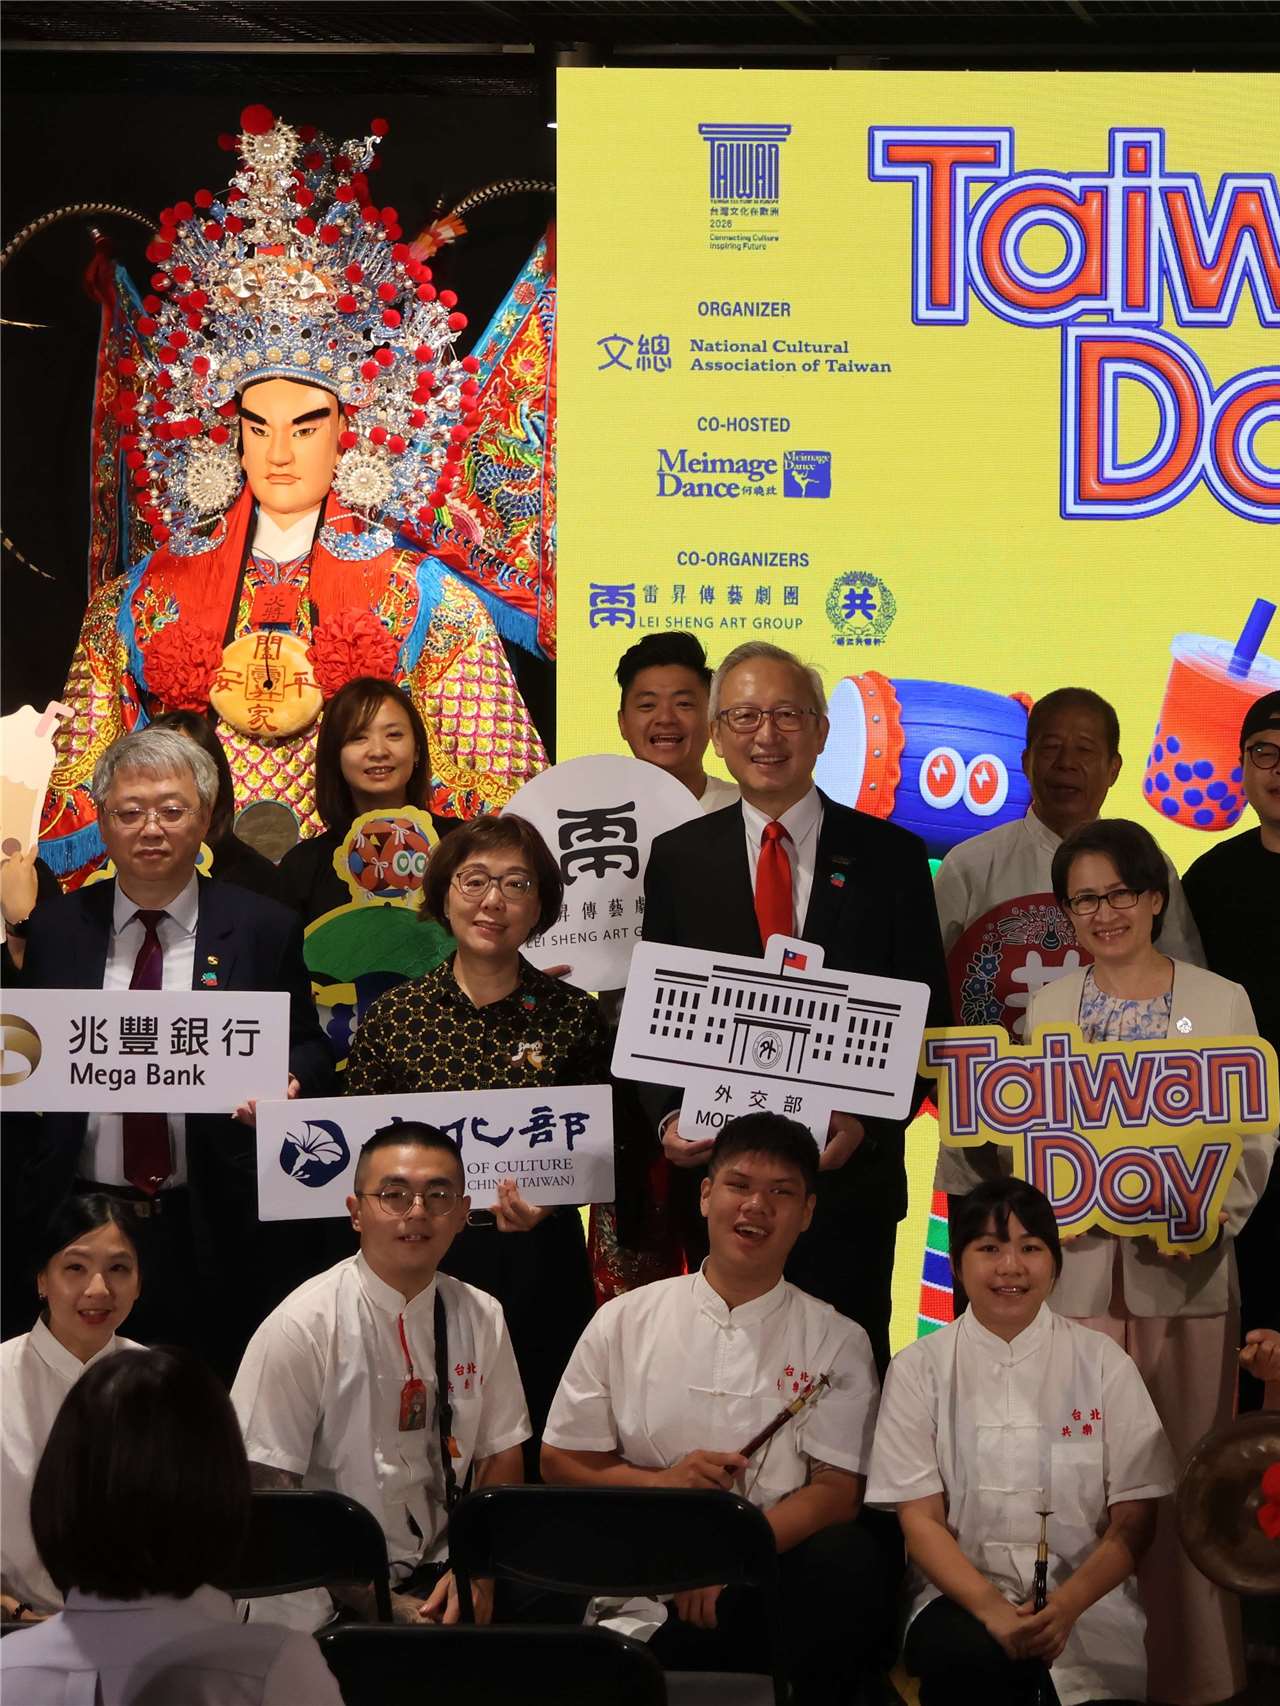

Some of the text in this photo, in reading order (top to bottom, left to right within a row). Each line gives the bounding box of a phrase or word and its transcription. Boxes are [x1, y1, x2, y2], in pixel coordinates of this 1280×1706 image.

[697, 301, 791, 318] ORGANIZER
[690, 338, 849, 354] National Cultural
[690, 357, 892, 373] Association of Taiwan
[697, 416, 791, 433] CO-HOSTED
[656, 448, 778, 482] Meimage
[783, 451, 831, 465] Meimage
[656, 472, 741, 499] Dance
[676, 550, 810, 568] CO-ORGANIZERS
[643, 584, 800, 607] 雷昇傳藝劇團
[842, 587, 877, 620] 共
[639, 616, 804, 630] LEI SHENG ART GROUP
[557, 895, 646, 923] 昇傳藝劇
[526, 935, 546, 950] LEI
[551, 930, 598, 947] SHENG
[602, 927, 630, 941] ART
[68, 1015, 261, 1057] 兆豐銀行
[70, 1062, 206, 1091] Mega Bank
[926, 1033, 1268, 1136] Taiwan
[714, 1083, 804, 1116] 外交部
[695, 1109, 735, 1128] MOF
[467, 1158, 574, 1175] OF CULTURE
[1023, 1130, 1232, 1244] Day
[454, 1362, 477, 1376] 台北
[1071, 1407, 1102, 1421] 台北
[1061, 1423, 1093, 1438] 共樂
